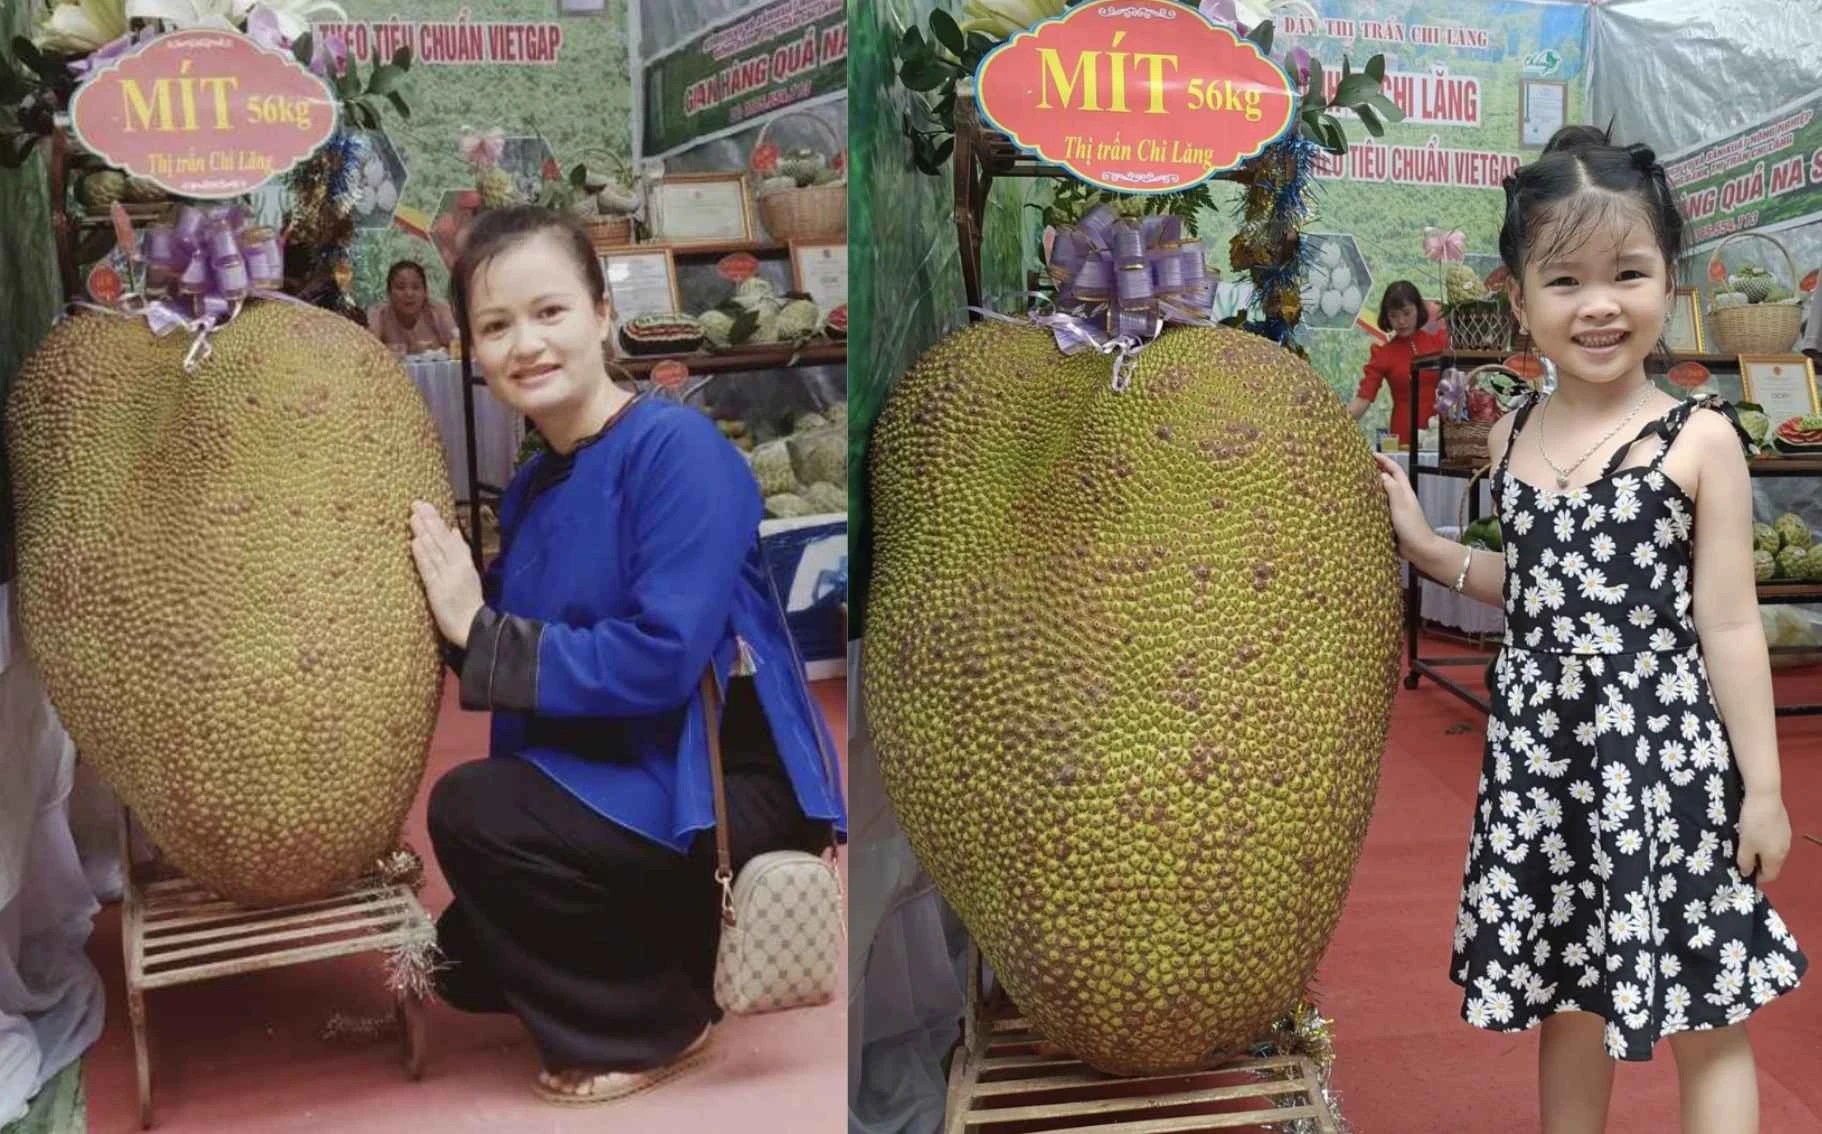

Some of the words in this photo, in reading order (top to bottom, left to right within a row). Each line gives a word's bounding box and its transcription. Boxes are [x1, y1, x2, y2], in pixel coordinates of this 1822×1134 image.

[420, 8, 483, 61] CHUẨN
[488, 24, 560, 61] VIETGAP
[774, 27, 815, 80] QUẢ
[1363, 17, 1404, 42] TRẤN
[1412, 26, 1440, 44] CHI
[1448, 23, 1488, 46] LĂNG
[118, 59, 239, 132] MÍT
[247, 95, 311, 130] 56kg
[1036, 31, 1179, 114] MÍT
[1187, 78, 1262, 122] 56kg
[1421, 70, 1478, 122] LĂNG
[1064, 135, 1093, 166] Thị
[1137, 138, 1168, 163] Chi
[1171, 140, 1215, 171] Lăng
[1350, 140, 1386, 180] TIÊU
[1392, 136, 1448, 183] CHUẨN
[1722, 164, 1763, 211] QUẢ
[1771, 158, 1803, 193] NA
